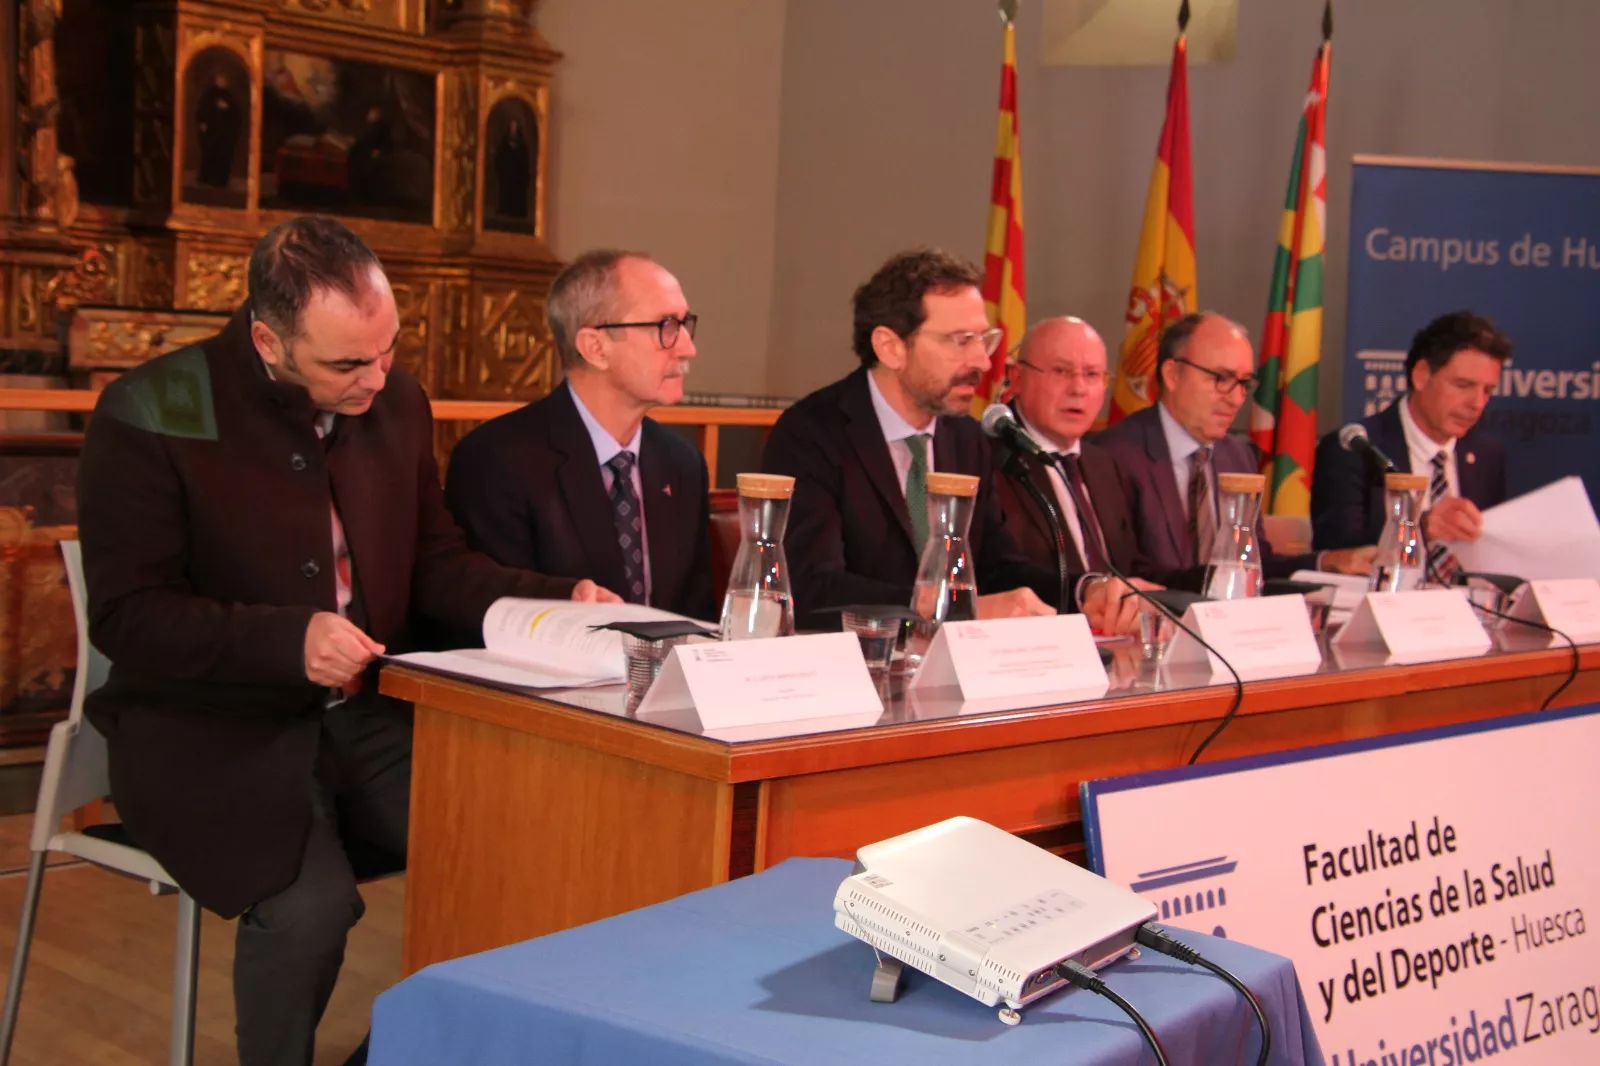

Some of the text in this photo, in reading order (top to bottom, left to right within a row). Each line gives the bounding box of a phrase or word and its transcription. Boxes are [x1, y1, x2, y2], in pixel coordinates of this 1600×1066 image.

[1365, 227, 1500, 272] Campus
[1508, 231, 1552, 268] de
[1492, 358, 1600, 399] iversi
[1480, 411, 1591, 442] ragoza
[1303, 816, 1457, 886] Facultad de
[1311, 849, 1556, 948] Ciencias de la Salud
[1318, 978, 1335, 1024] y
[1343, 952, 1386, 1004] del
[1391, 932, 1496, 990] Deporte
[1511, 908, 1587, 954] Huesca
[1332, 999, 1518, 1066] iersidad
